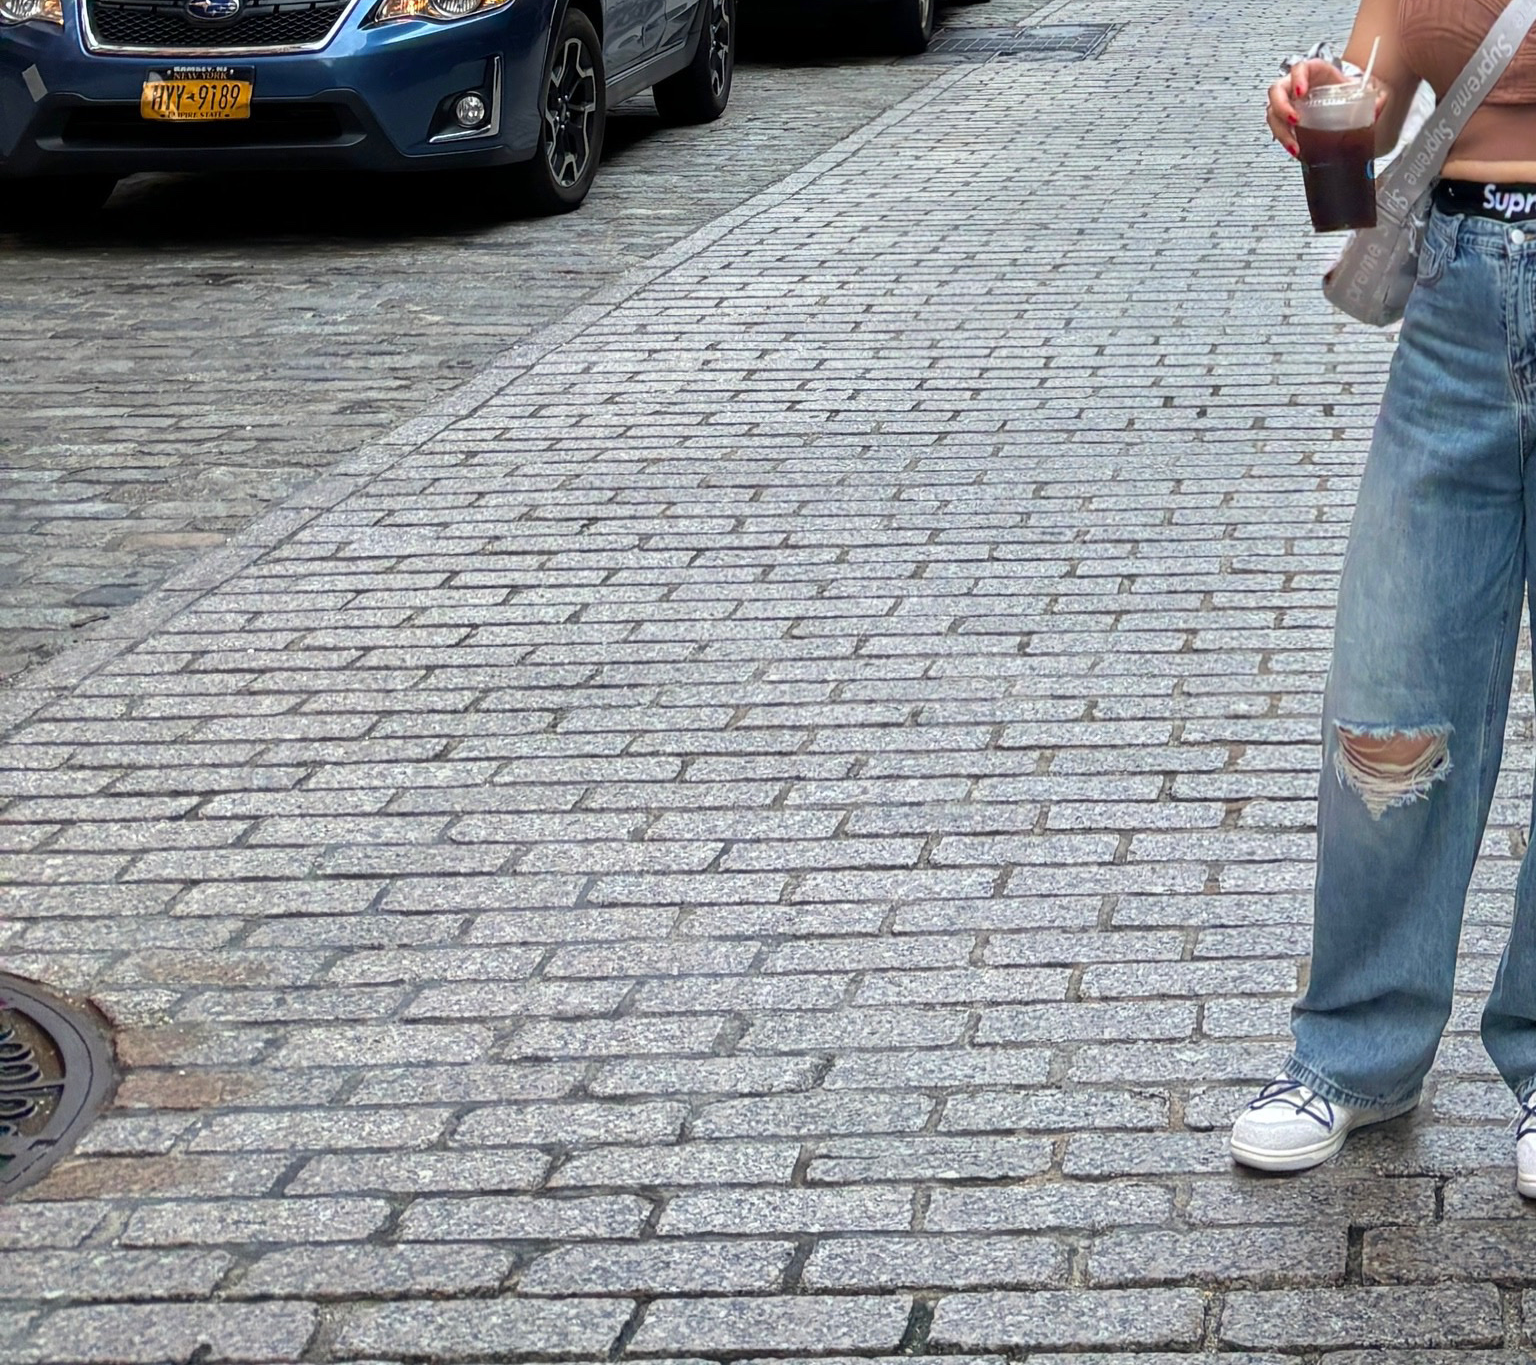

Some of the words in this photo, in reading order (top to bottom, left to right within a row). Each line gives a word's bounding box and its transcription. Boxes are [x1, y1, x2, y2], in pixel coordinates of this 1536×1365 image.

[1451, 34, 1513, 116] Supreme
[200, 110, 222, 118] STATE
[1404, 118, 1455, 185] Supreme
